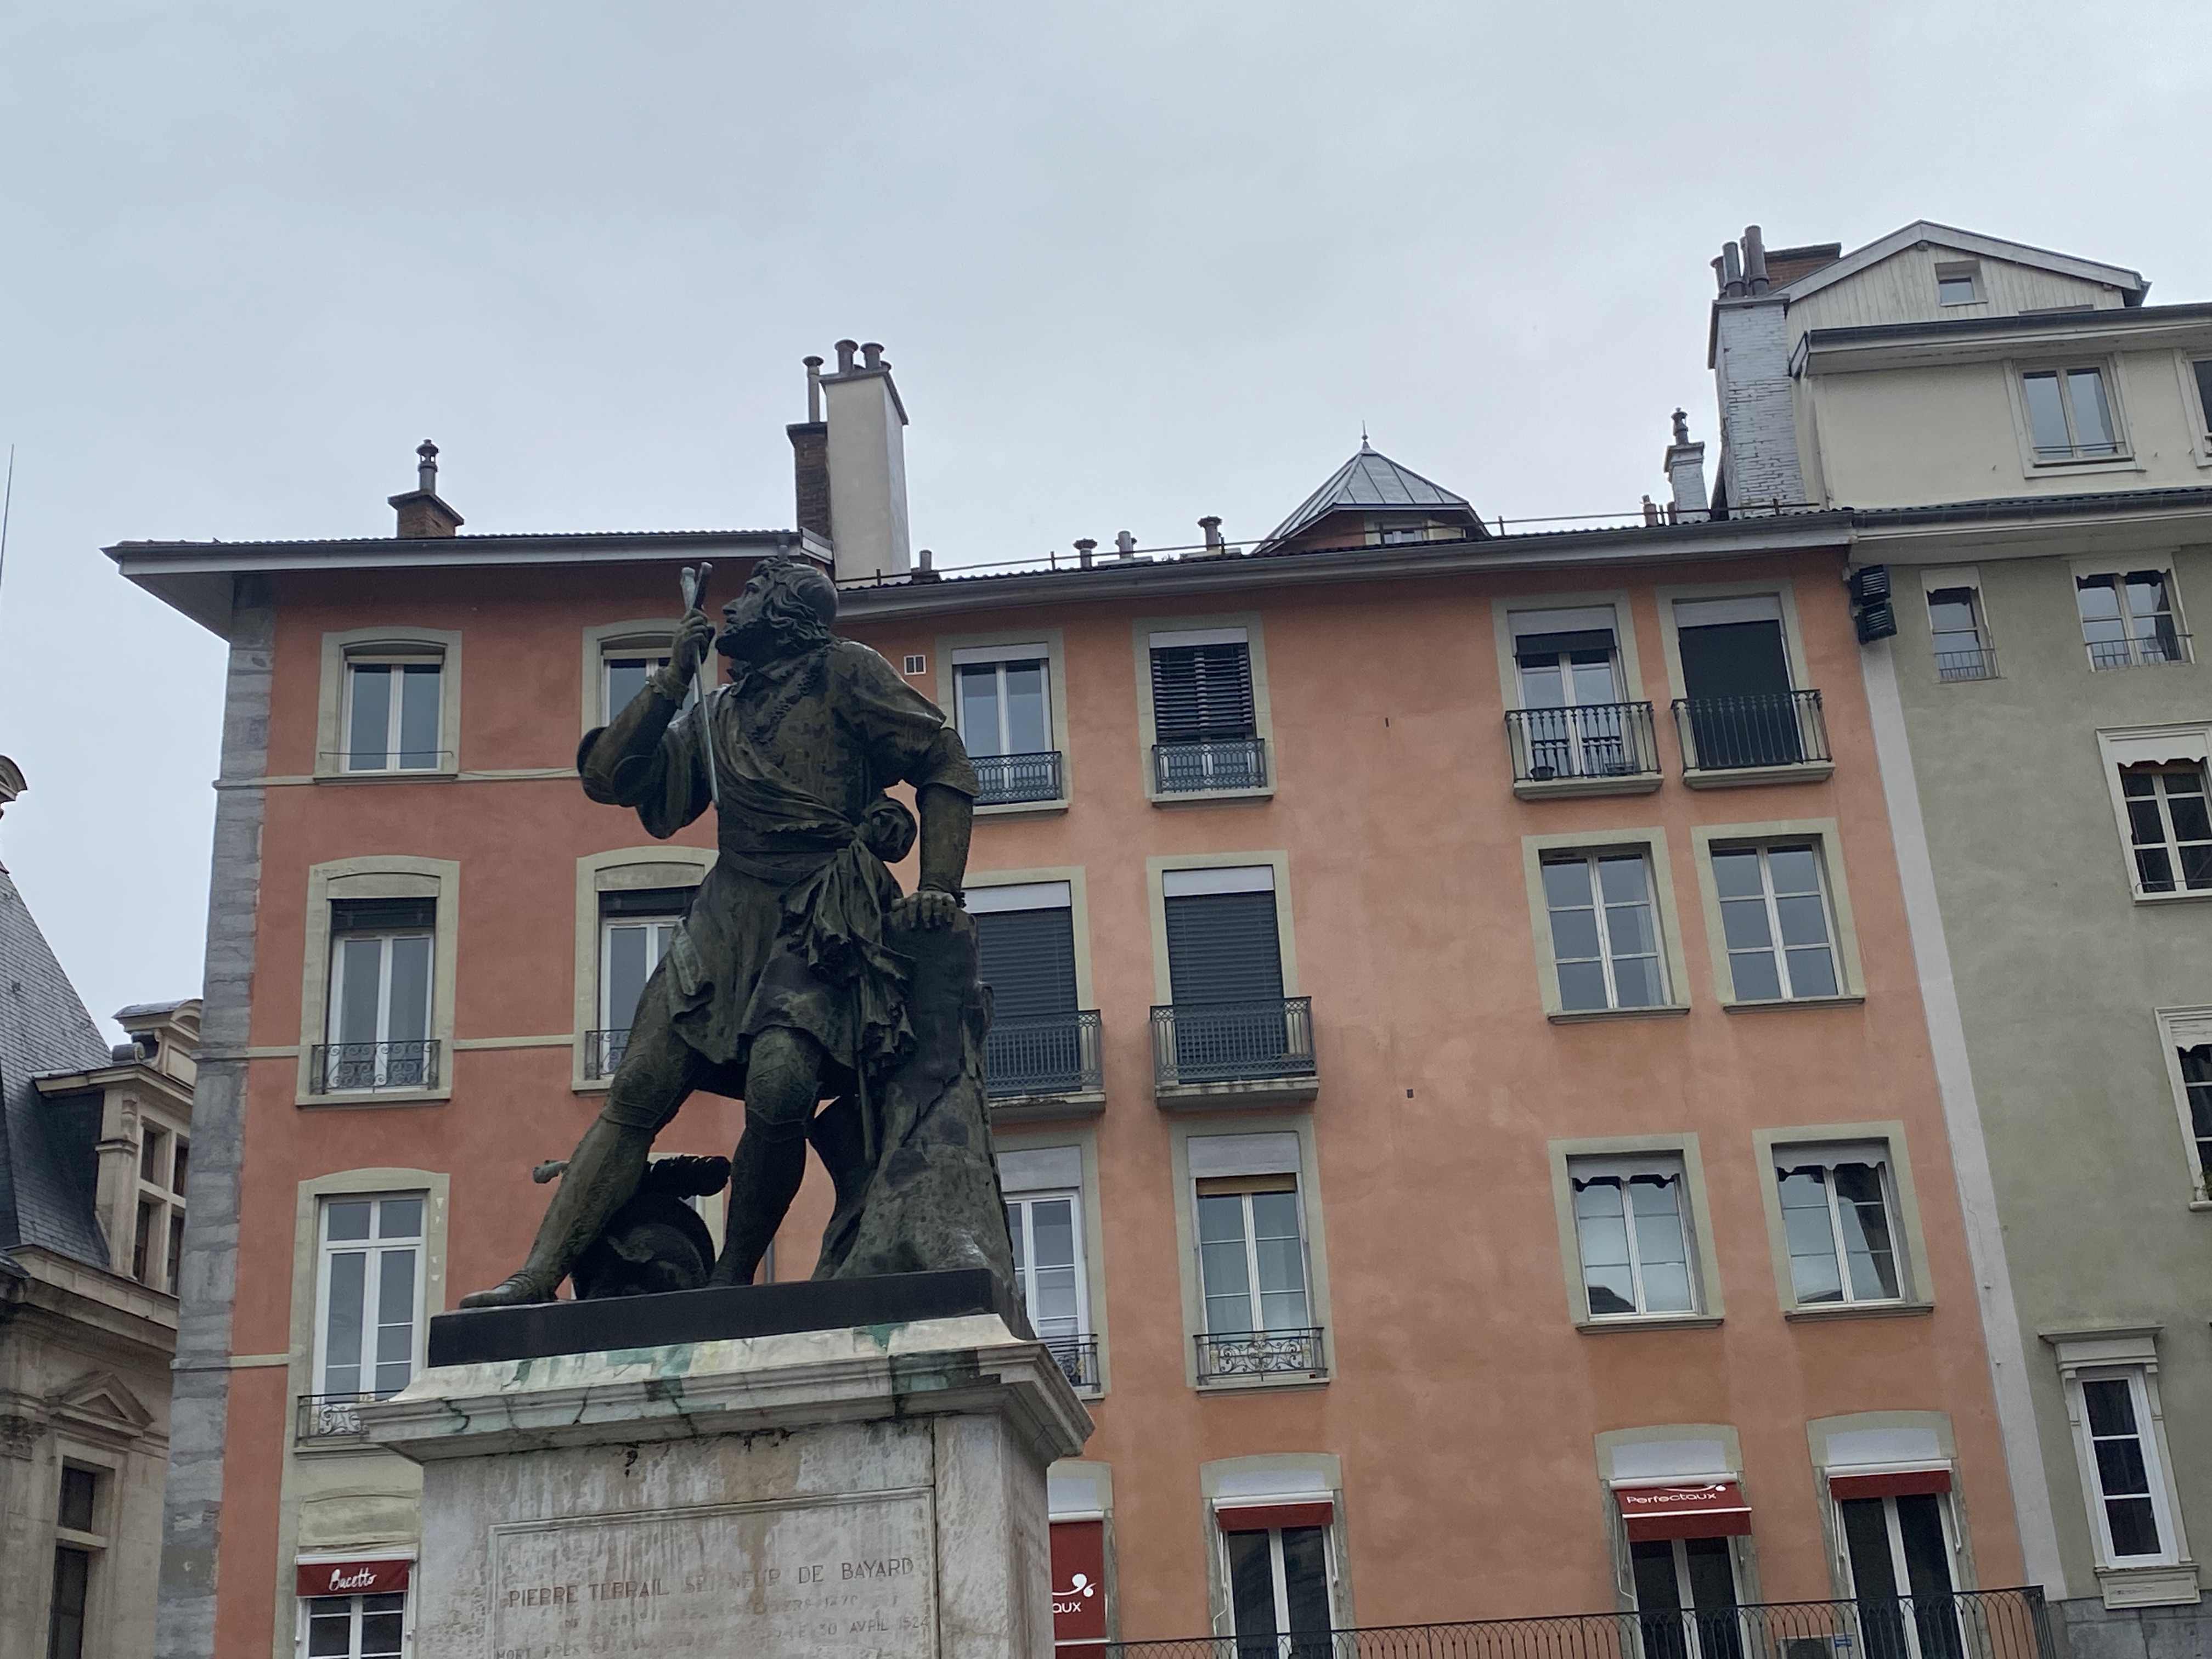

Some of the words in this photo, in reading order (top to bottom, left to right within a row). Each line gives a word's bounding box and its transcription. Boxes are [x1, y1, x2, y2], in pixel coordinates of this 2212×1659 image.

[1627, 1493, 1717, 1504] Perfectaux
[509, 1584, 579, 1608] PIERRE
[798, 1565, 823, 1584] DE
[841, 1558, 913, 1581] BAYARD
